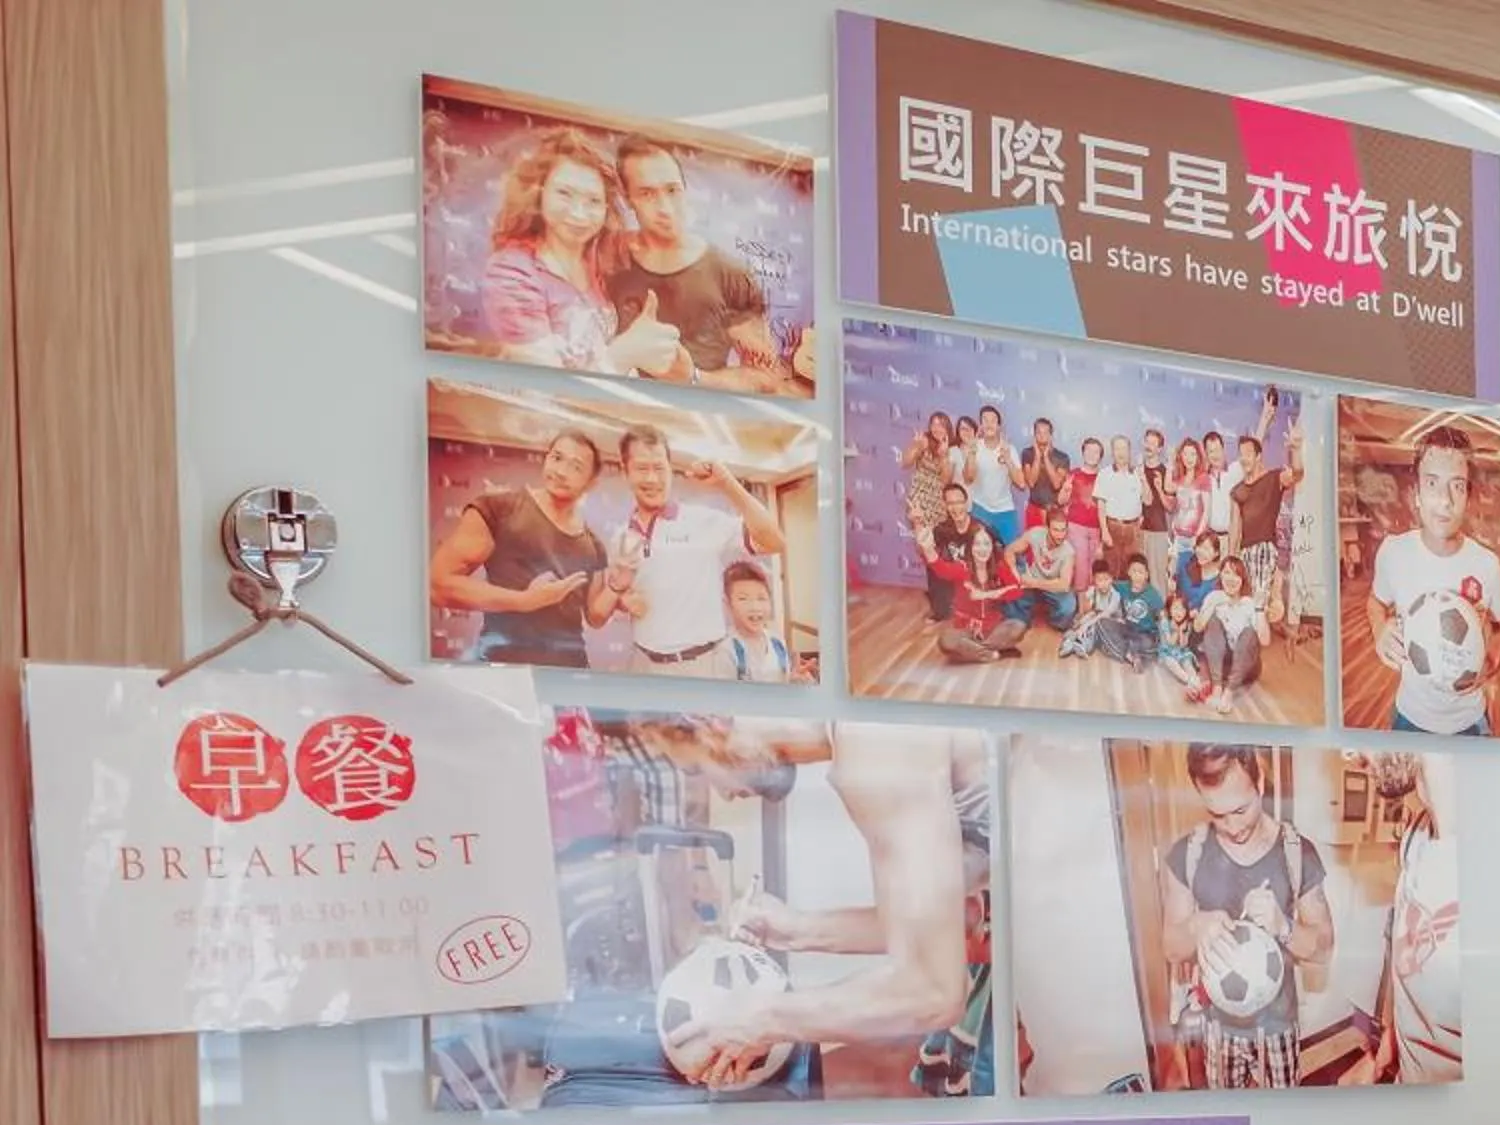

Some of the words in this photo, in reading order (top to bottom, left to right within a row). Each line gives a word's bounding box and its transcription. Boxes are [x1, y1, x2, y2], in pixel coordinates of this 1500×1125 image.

[899, 95, 1464, 284] 國際巨星來旅悅
[901, 204, 1092, 264] International
[1106, 245, 1172, 279] stars
[1184, 254, 1249, 290] have
[1261, 271, 1345, 310] stayed
[1356, 290, 1381, 315] at
[1392, 292, 1464, 329] D'well
[189, 716, 412, 817] 早餐
[119, 832, 482, 882] BREAKFAST
[444, 921, 525, 978] FREE
